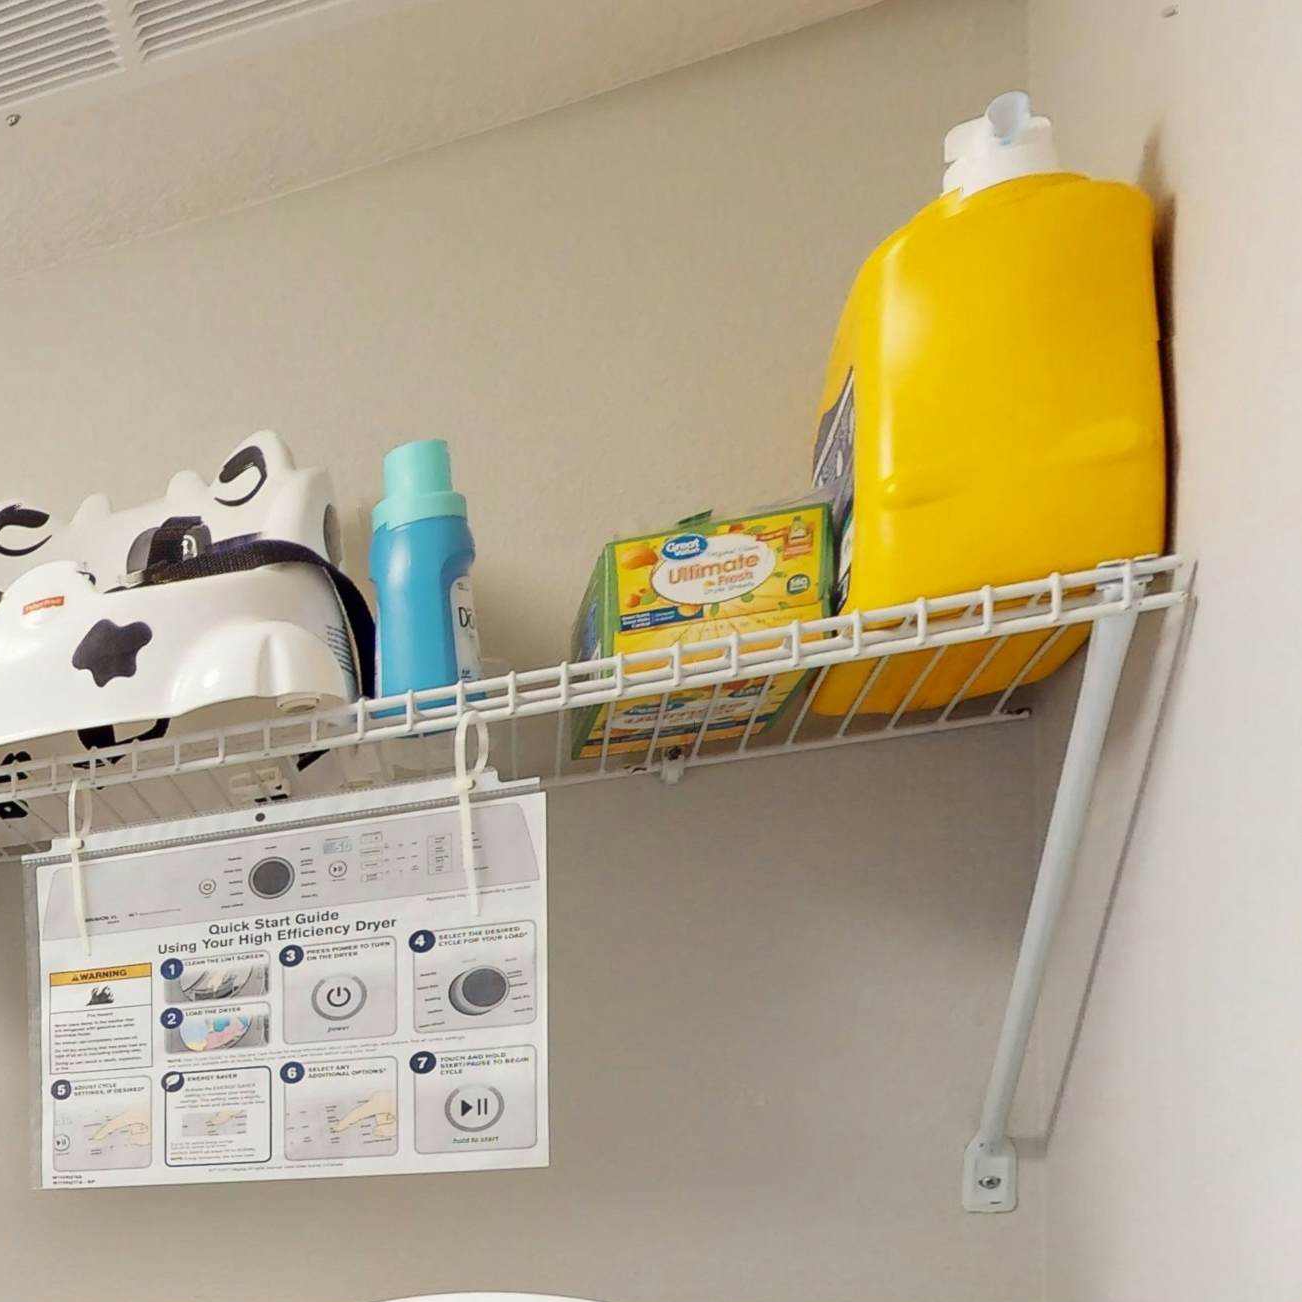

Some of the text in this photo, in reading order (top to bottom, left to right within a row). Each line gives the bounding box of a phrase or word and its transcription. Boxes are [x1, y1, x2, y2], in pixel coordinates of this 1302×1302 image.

[667, 554, 760, 585] Ultimate
[718, 570, 754, 585] Fresh
[208, 909, 340, 936] Quick Start Guide
[158, 918, 398, 955] Using Your High Efficiency Dryer
[439, 932, 465, 940] SELECT
[484, 926, 520, 936] DESIRED
[414, 934, 427, 948] 4
[439, 939, 462, 947] CYCLE
[479, 934, 502, 944] YOUR
[307, 947, 330, 955] PRESS
[331, 944, 358, 953] POWER
[371, 941, 391, 949] TURN
[184, 953, 265, 967] CLEAN THE LINT SCREEN
[285, 950, 297, 963] 3
[333, 951, 359, 959] DRYER
[79, 969, 128, 981] WARNING
[185, 1009, 203, 1017] LOAD
[218, 1006, 242, 1014] DRYER
[167, 1012, 178, 1025] 2
[417, 1056, 429, 1069] 7
[440, 1054, 466, 1062] TOUCH
[485, 1051, 508, 1059] HOLD
[440, 1059, 492, 1069] START/PAUSE
[505, 1056, 530, 1064] BEGIN
[287, 1066, 298, 1079] 6
[307, 1070, 350, 1079] ADDITIONAL
[308, 1065, 334, 1073] SELECT
[439, 1068, 464, 1076] CYCLE
[56, 1084, 67, 1097] 5
